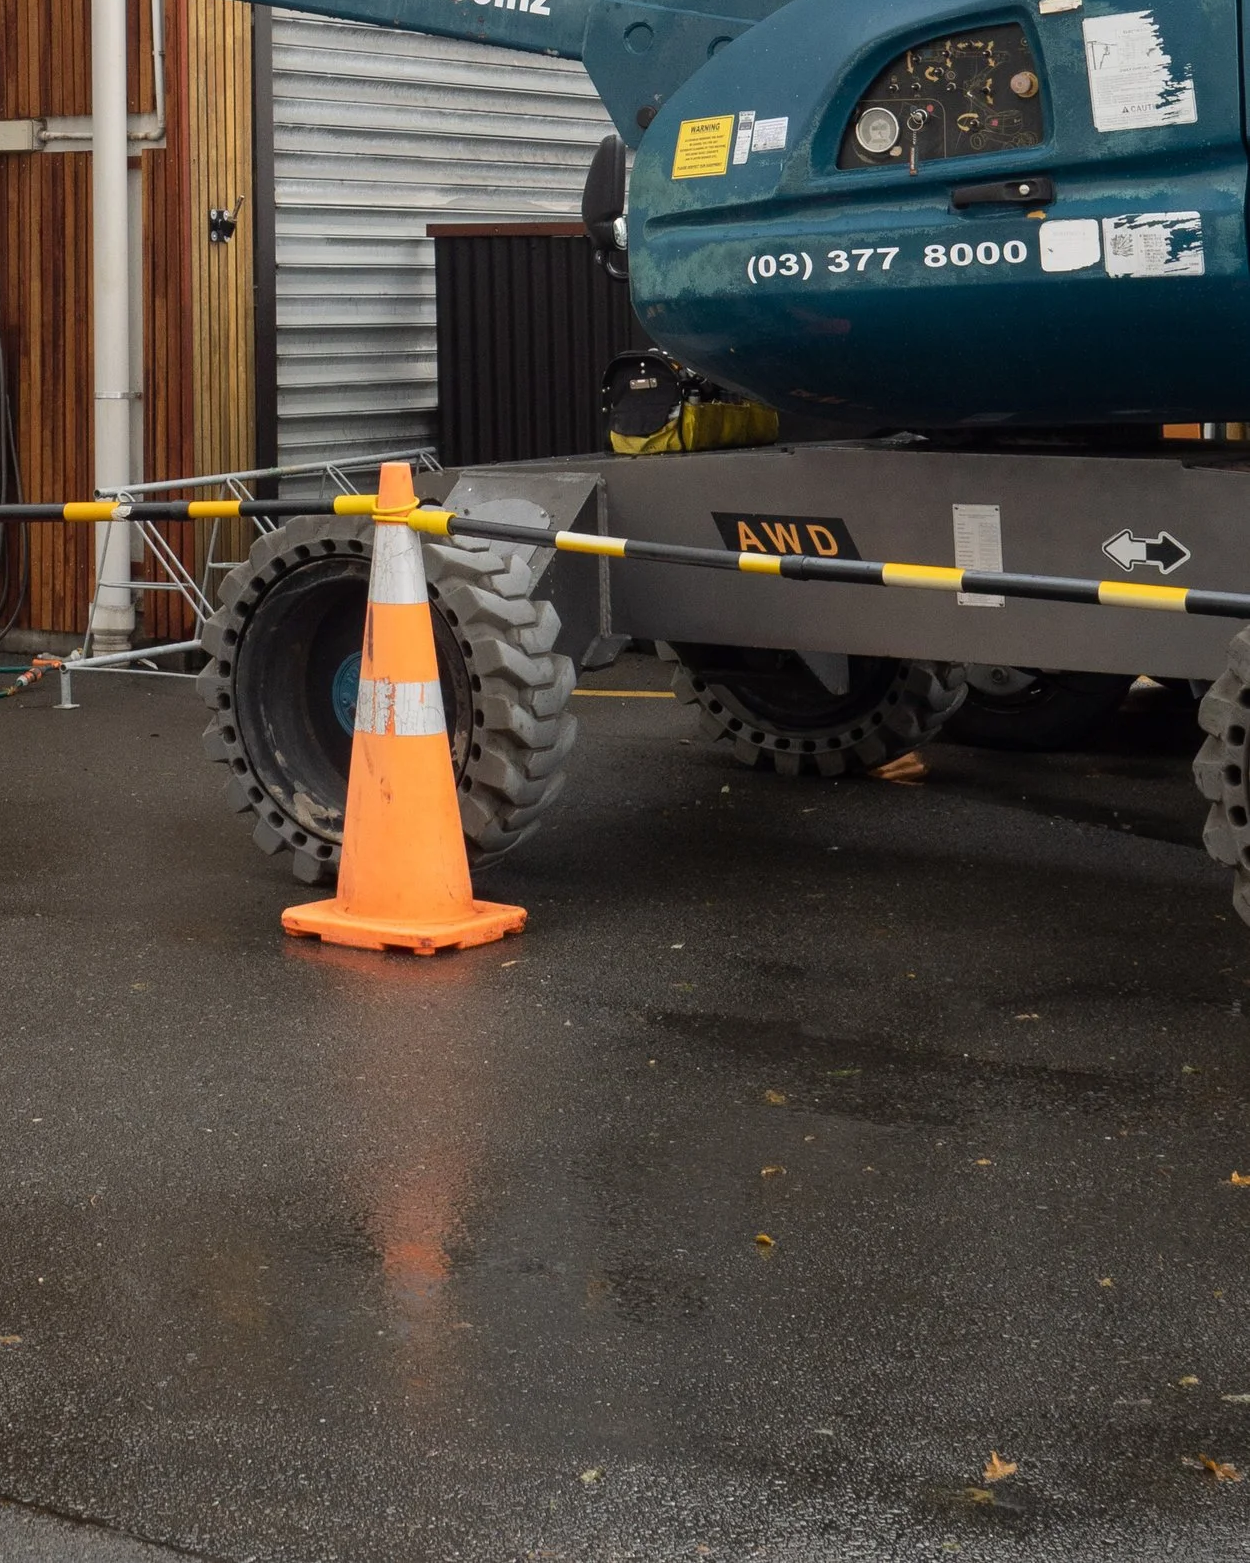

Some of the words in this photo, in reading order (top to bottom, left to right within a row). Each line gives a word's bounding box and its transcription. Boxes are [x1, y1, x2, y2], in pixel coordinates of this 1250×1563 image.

[690, 122, 721, 133] WARNING
[747, 252, 813, 284] (03)
[827, 247, 900, 273] 377
[924, 240, 1028, 267] 8000
[737, 520, 839, 556] AWD
